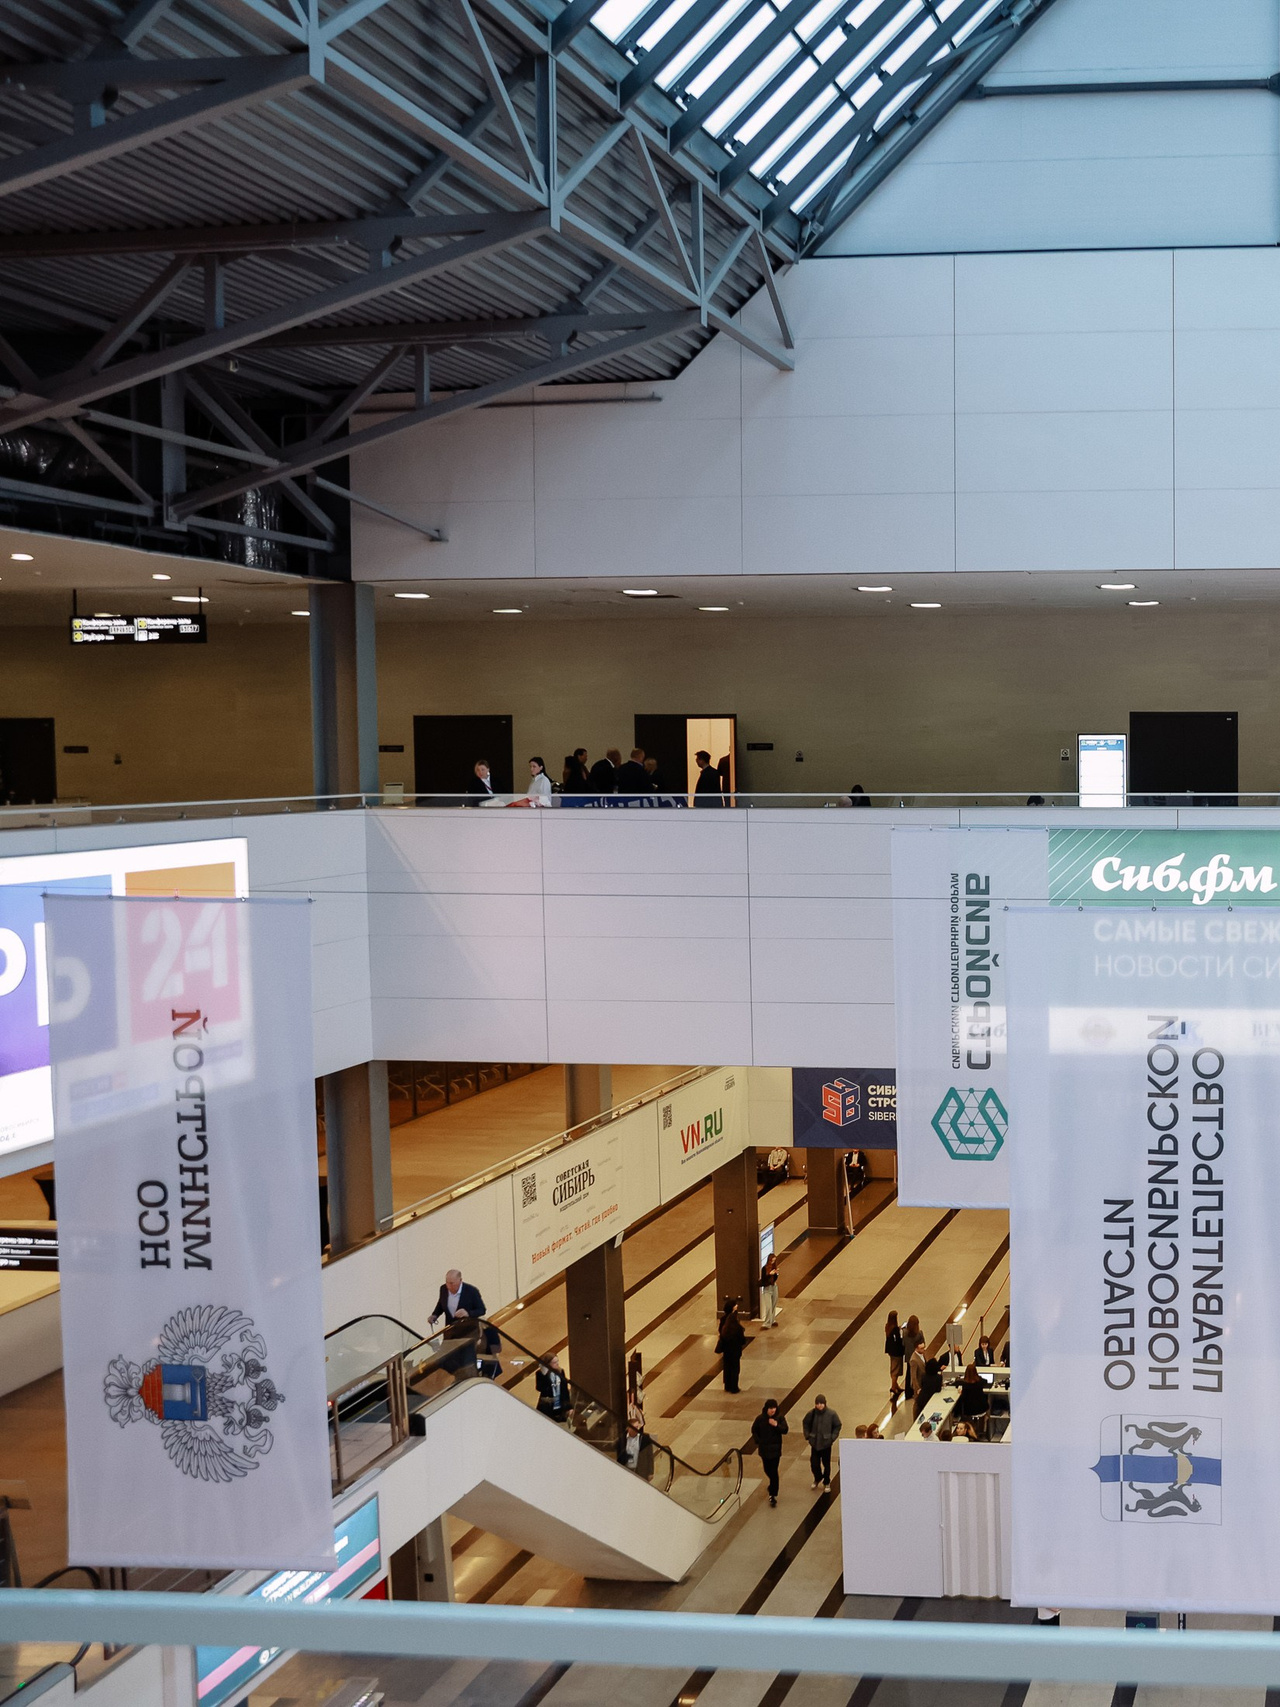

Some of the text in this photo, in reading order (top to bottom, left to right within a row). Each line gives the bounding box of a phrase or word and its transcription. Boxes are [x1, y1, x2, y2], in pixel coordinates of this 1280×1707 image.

[1092, 853, 1277, 905] Сиб.фм
[1093, 919, 1197, 943] САМЫЕ
[1094, 954, 1234, 978] НОВОСТИ
[680, 1107, 723, 1155] VN.RU
[555, 1159, 590, 1184] СОВЕТСКАЯ
[552, 1168, 596, 1207] СИБИРЬ
[531, 1245, 551, 1264] Новый
